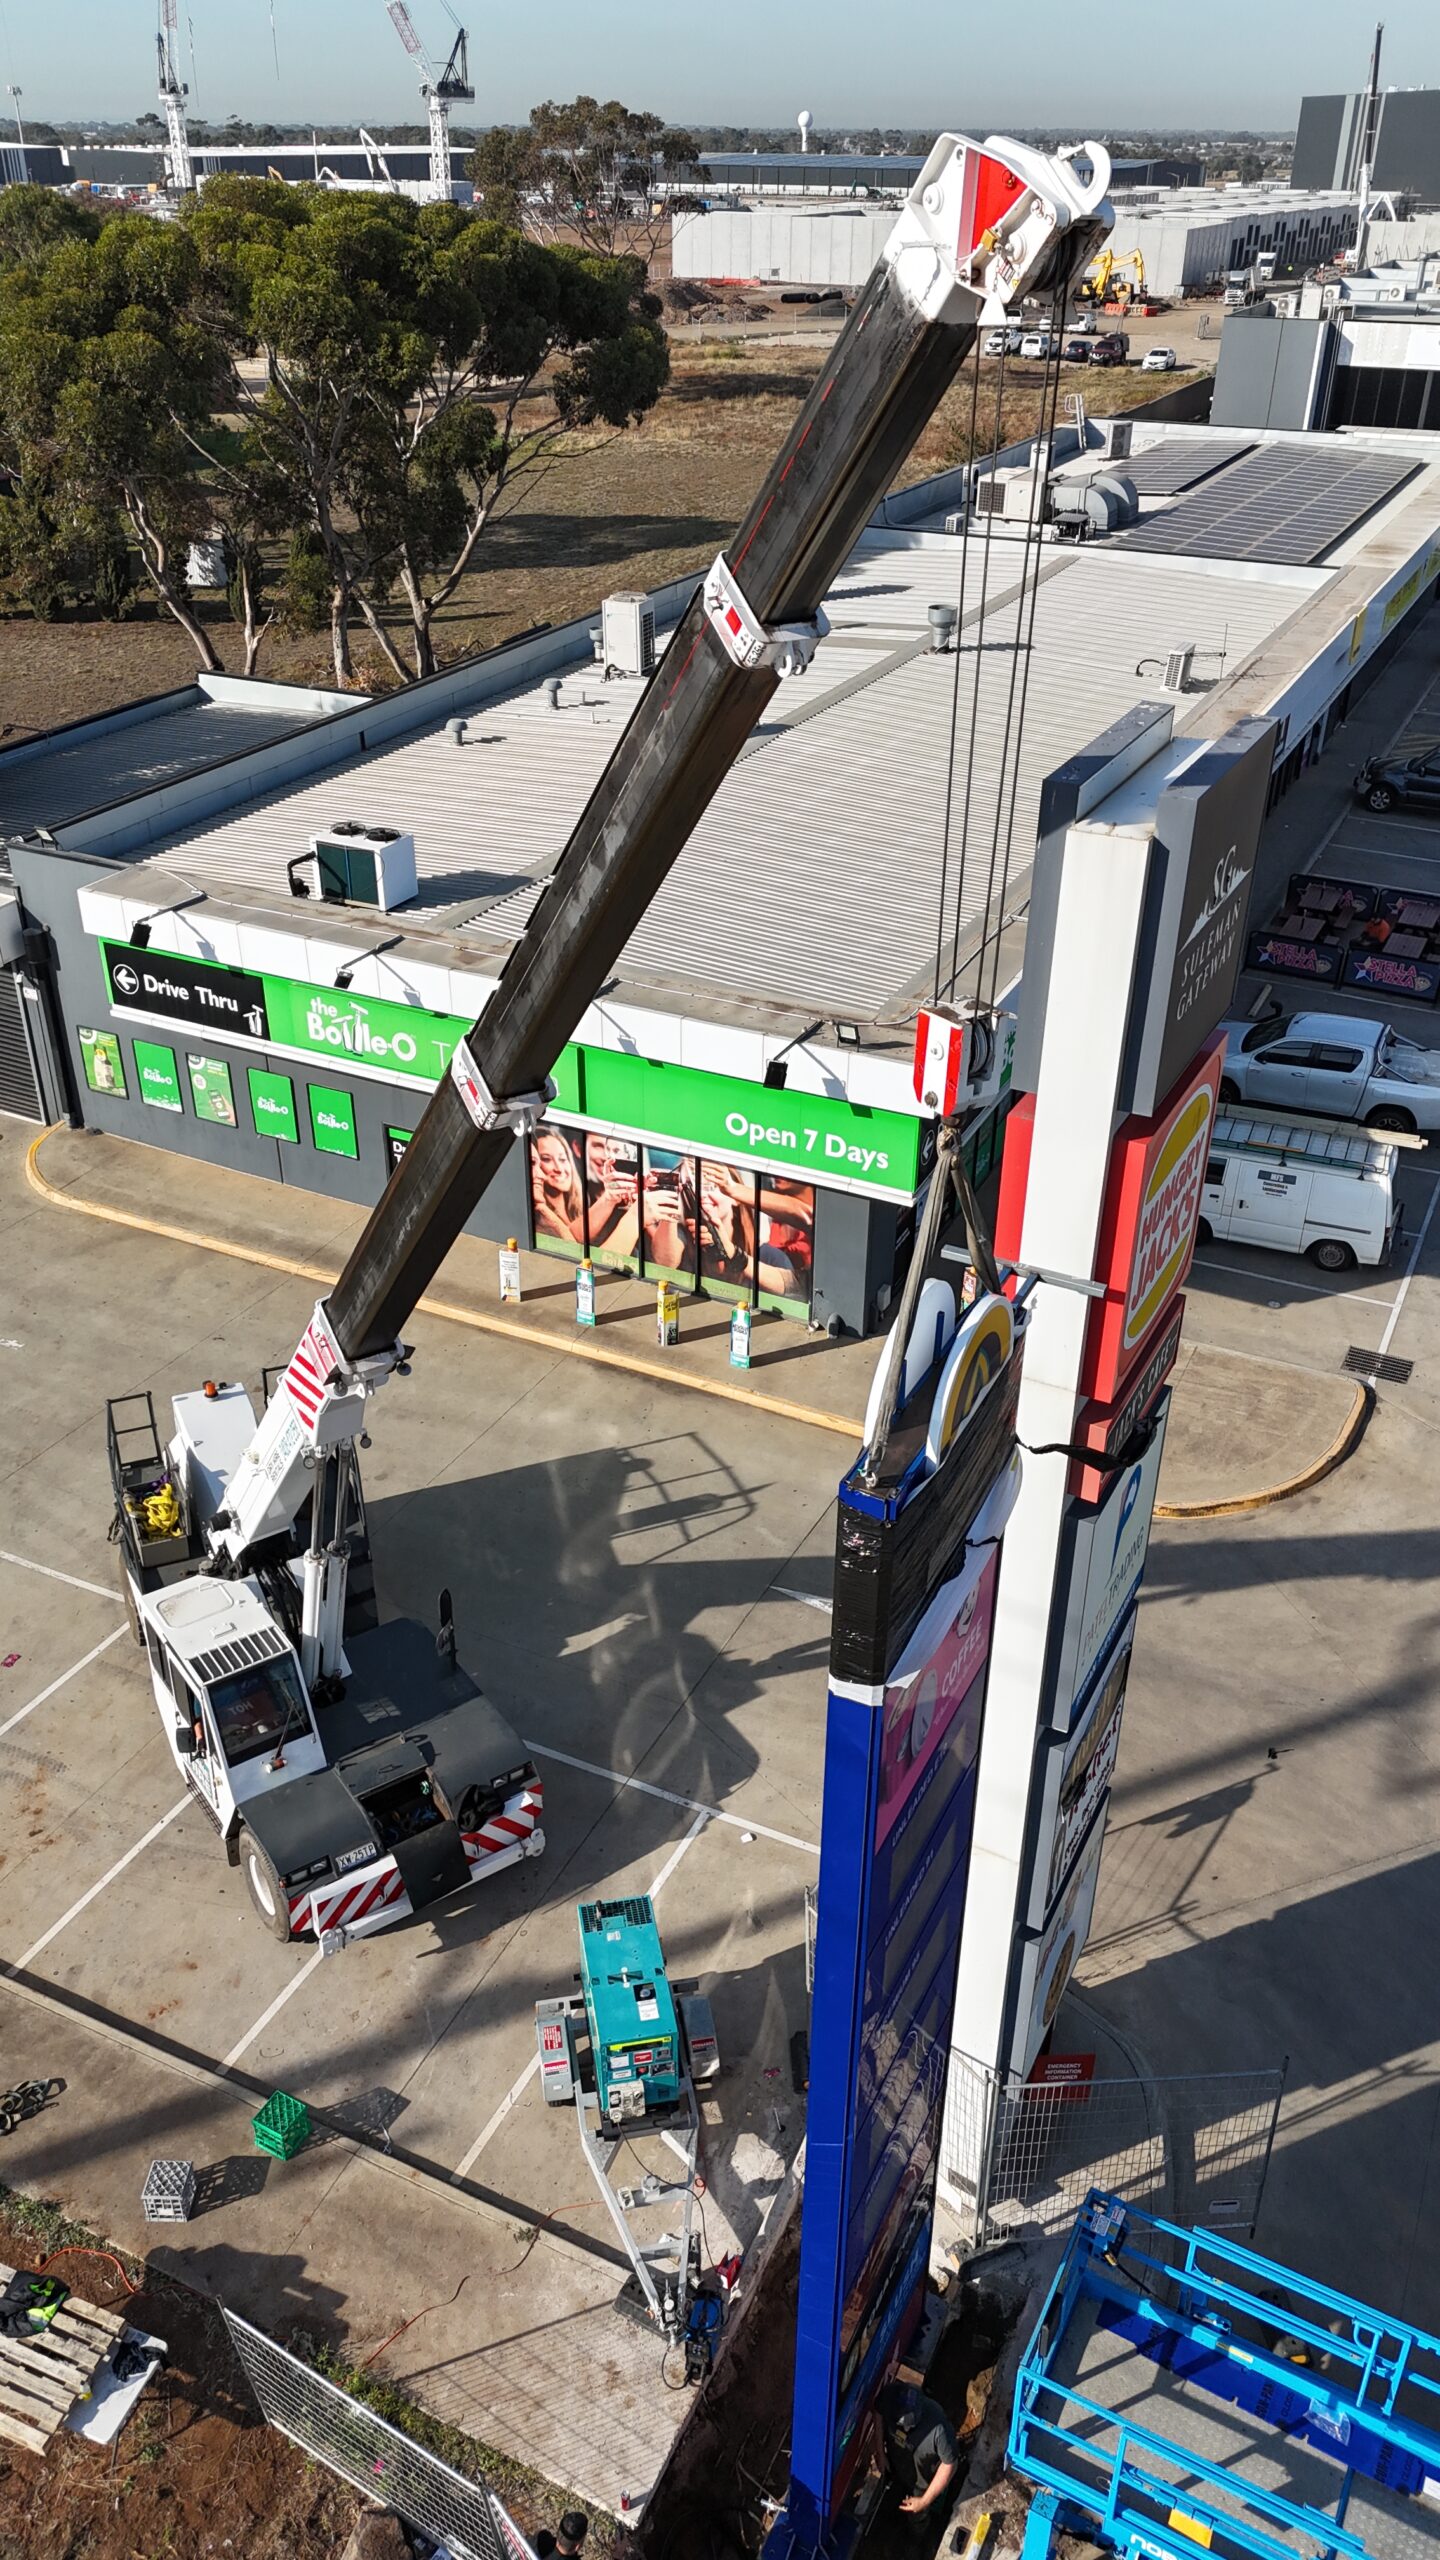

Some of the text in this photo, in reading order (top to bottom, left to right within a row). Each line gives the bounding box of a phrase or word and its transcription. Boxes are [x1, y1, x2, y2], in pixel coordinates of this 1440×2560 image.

[1176, 931, 1236, 1021] GATEWAY
[1181, 897, 1241, 987] SULEMAN
[1271, 941, 1317, 961] STELLA
[1276, 954, 1316, 972] PIZZA
[1370, 958, 1417, 978] STELLA
[1374, 971, 1414, 988] PIZZA
[143, 974, 239, 1012] Drive Thru
[310, 996, 338, 1017] the
[725, 1112, 889, 1172] Open 7 Days
[1139, 1131, 1206, 1253] HUNGRY
[1131, 1175, 1198, 1311] JACK'S
[1108, 1525, 1146, 1604] TRADING
[941, 1615, 984, 1698] COFFEE
[891, 1772, 934, 1847] UNLEADED
[884, 1868, 925, 1947] UNLEADED
